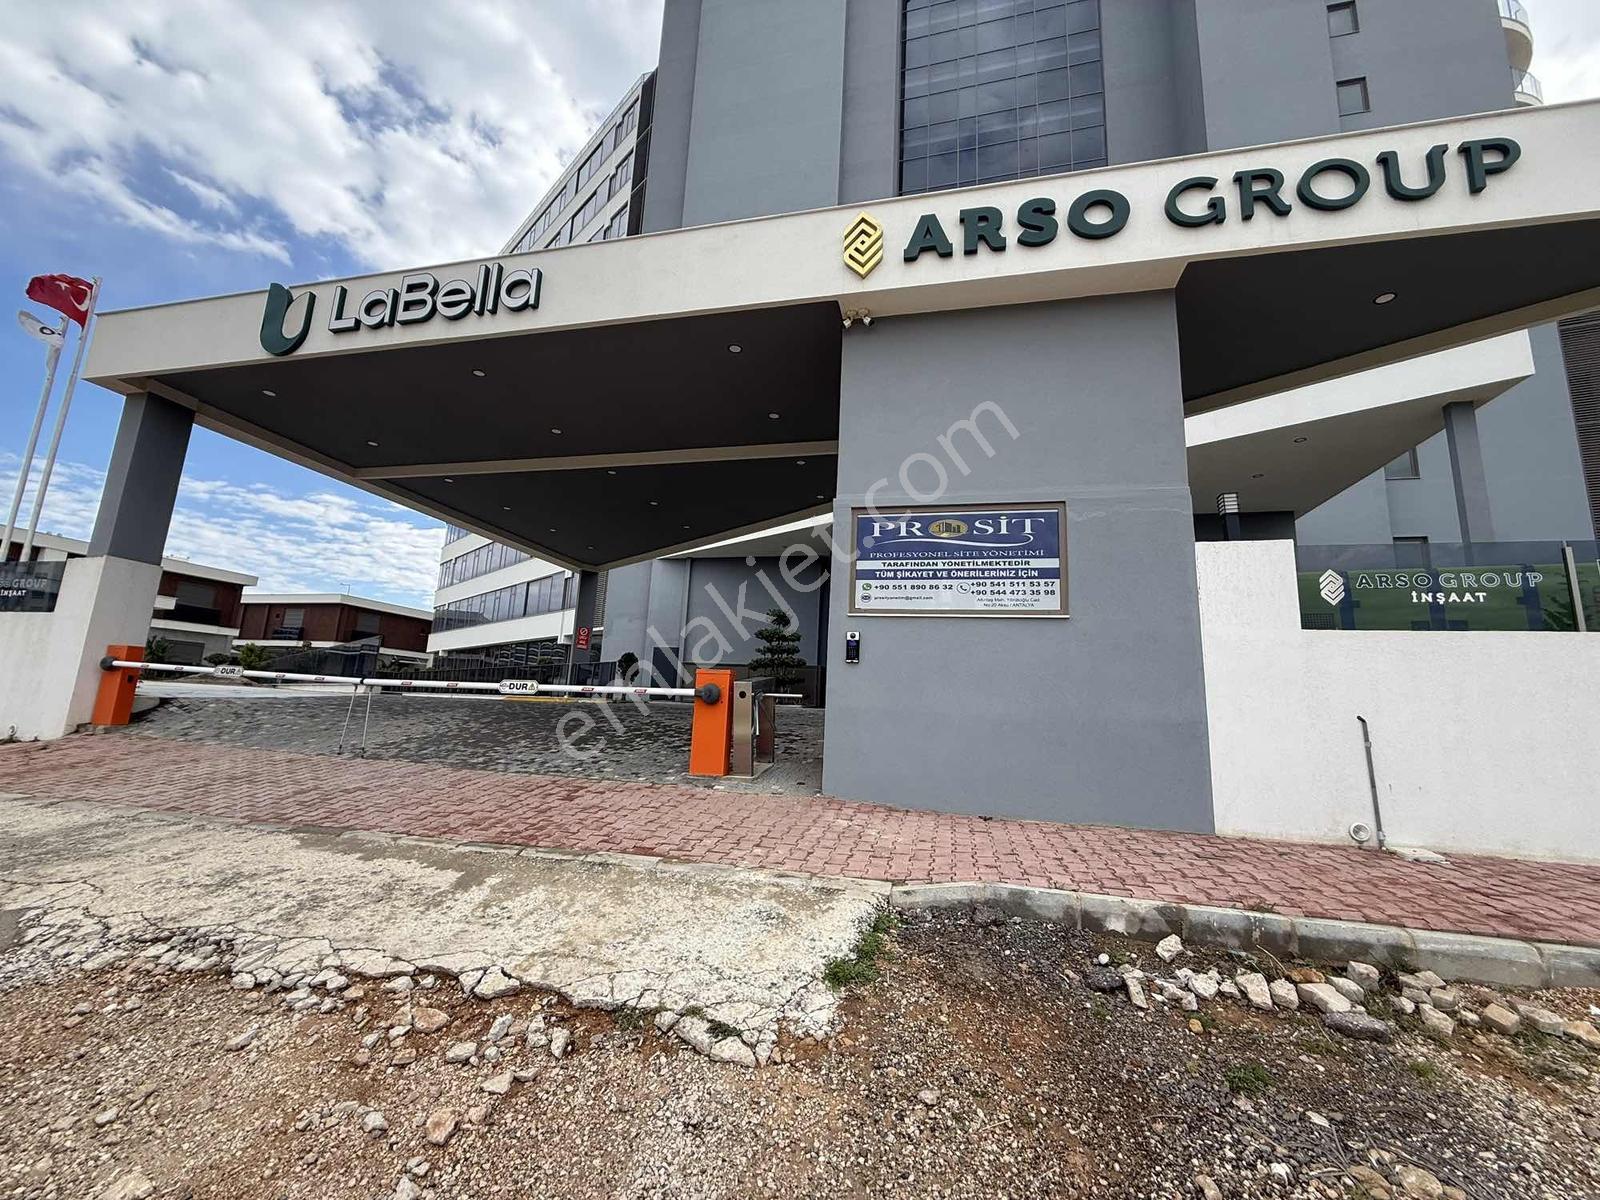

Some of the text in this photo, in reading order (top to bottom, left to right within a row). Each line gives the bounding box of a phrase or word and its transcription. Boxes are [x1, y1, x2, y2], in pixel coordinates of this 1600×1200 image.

[903, 136, 1522, 262] ARSO GROUP
[328, 262, 543, 333] LaBella
[981, 549, 1044, 557] YÖNETİMİ
[941, 559, 1031, 567] YÖNETİLMEKTEDİR
[875, 570, 894, 578] TÜM
[896, 570, 934, 578] ŞİKAYET
[950, 569, 1016, 577] ÖNERİLERİNİZ
[1018, 569, 1038, 578] İÇİN
[12, 578, 48, 589] GROUP
[1356, 572, 1543, 589] ARSO GROUP
[0, 589, 27, 597] İNŞAAT
[1411, 590, 1487, 605] İNŞAAT
[220, 667, 236, 675] DUR
[509, 682, 528, 690] DUR
